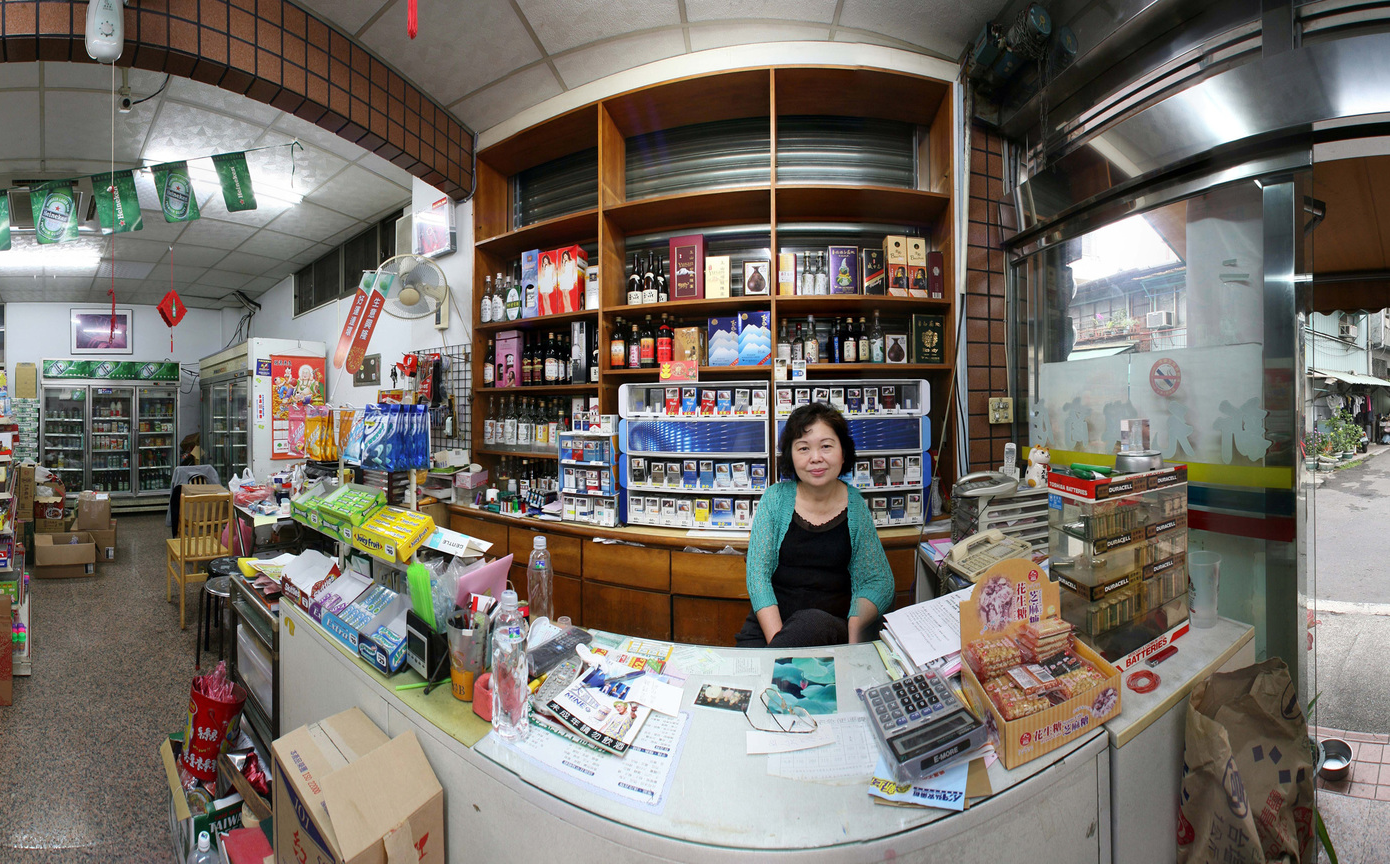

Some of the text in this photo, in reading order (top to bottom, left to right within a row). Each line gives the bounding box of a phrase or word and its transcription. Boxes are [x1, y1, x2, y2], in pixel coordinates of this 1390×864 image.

[230, 166, 244, 199] Heineken
[42, 209, 69, 224] Heineken
[1157, 474, 1178, 484] DURACELL
[1049, 481, 1088, 496] TOSHIBA BATTERIES
[1108, 483, 1133, 494] DURACELL
[1155, 520, 1176, 533] DURACELL
[355, 531, 381, 550] Juicy Fruit
[1106, 535, 1131, 547] DURACELL
[1153, 559, 1174, 572] DURACELL
[1104, 578, 1130, 593] DURACELL
[1016, 582, 1027, 621] 花生糖
[1028, 590, 1040, 624] 芝麻糖
[326, 618, 349, 641] Extra
[1125, 637, 1168, 668] BATTERIES
[565, 692, 586, 708] MINE
[549, 701, 627, 752] 未成年請勿飲酒
[1034, 714, 1089, 741] 花生糖 芝麻糖
[932, 746, 959, 764] E-MORE
[209, 814, 243, 833] TAIWA
